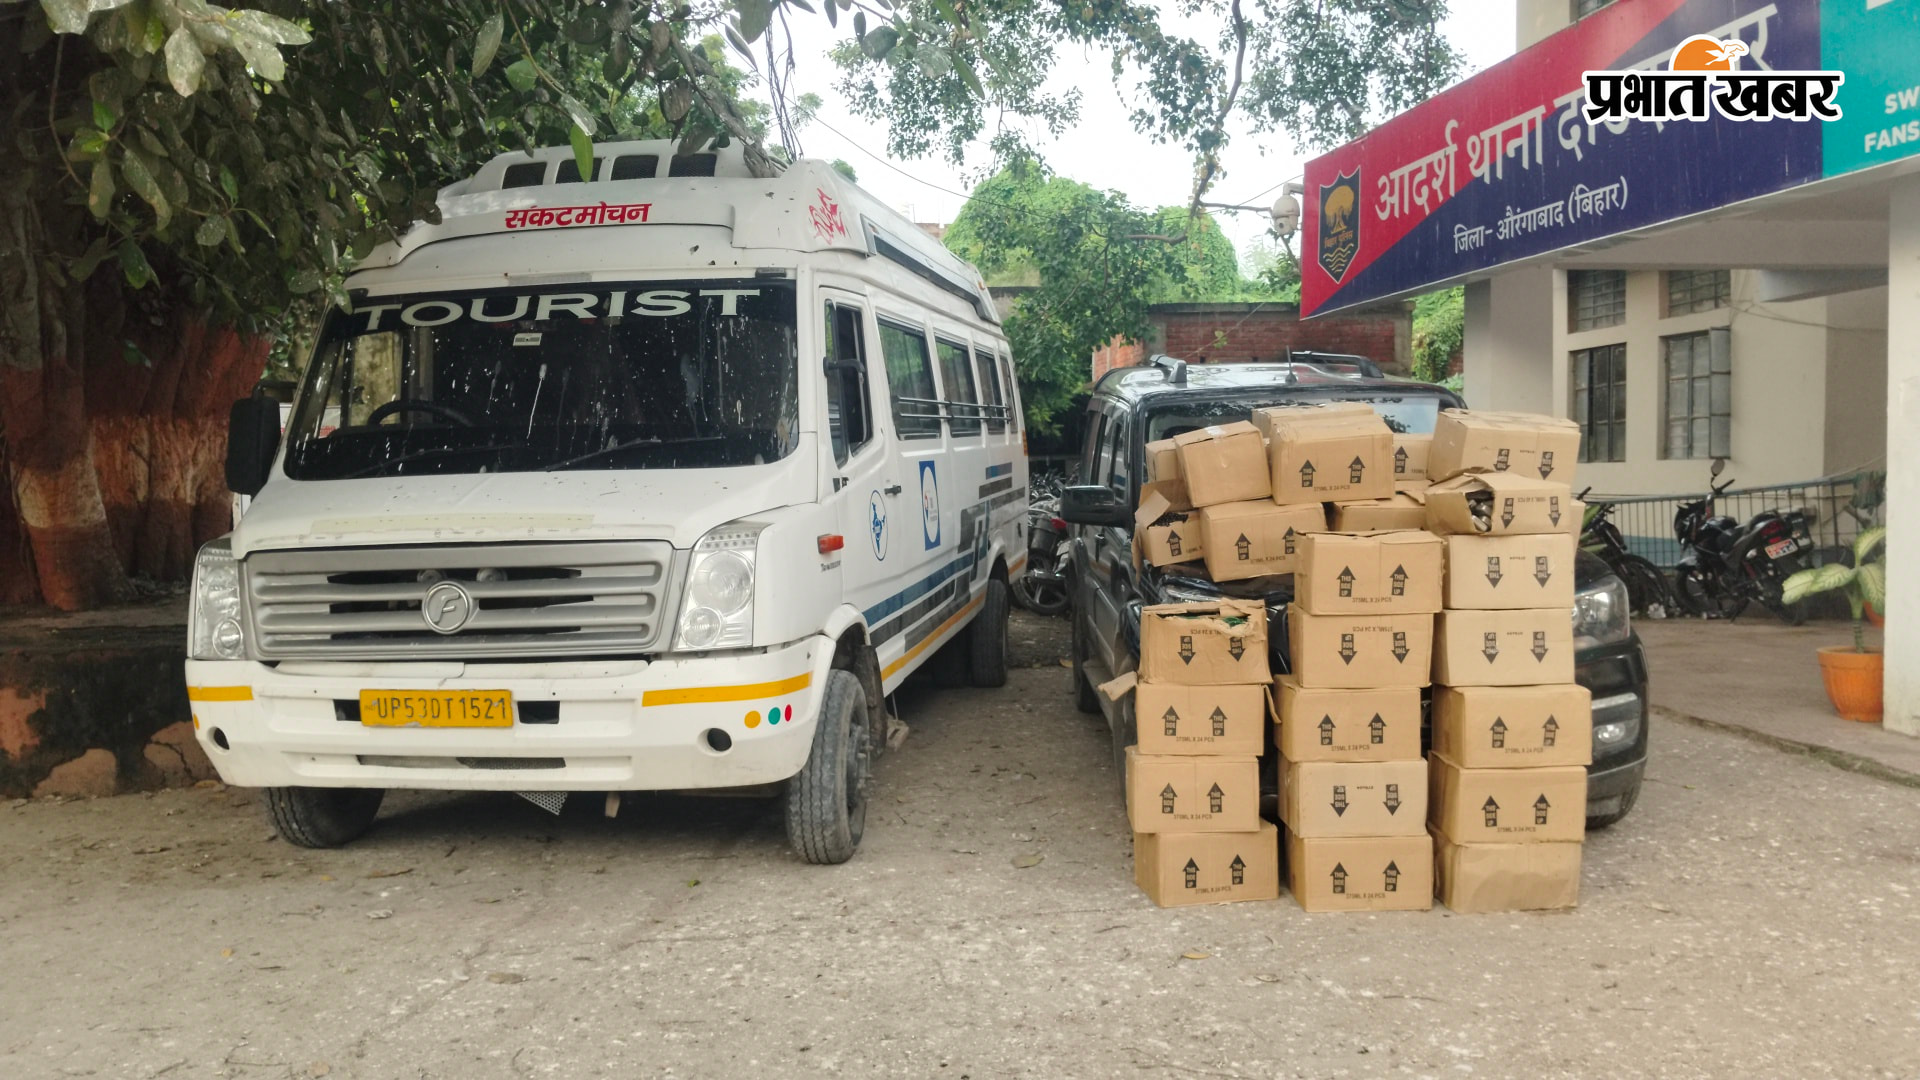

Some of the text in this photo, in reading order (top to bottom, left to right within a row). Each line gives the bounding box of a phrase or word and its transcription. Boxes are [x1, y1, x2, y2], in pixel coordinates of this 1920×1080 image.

[1864, 120, 1920, 153] FANS
[1375, 105, 1547, 221] आदर्श थाना
[504, 200, 653, 231] संकटमोचन
[1496, 205, 1565, 240] औरंगाबाद
[1568, 175, 1628, 223] (बिहार)
[353, 288, 761, 331] TOURIST
[377, 697, 507, 720] UP53DT1521
